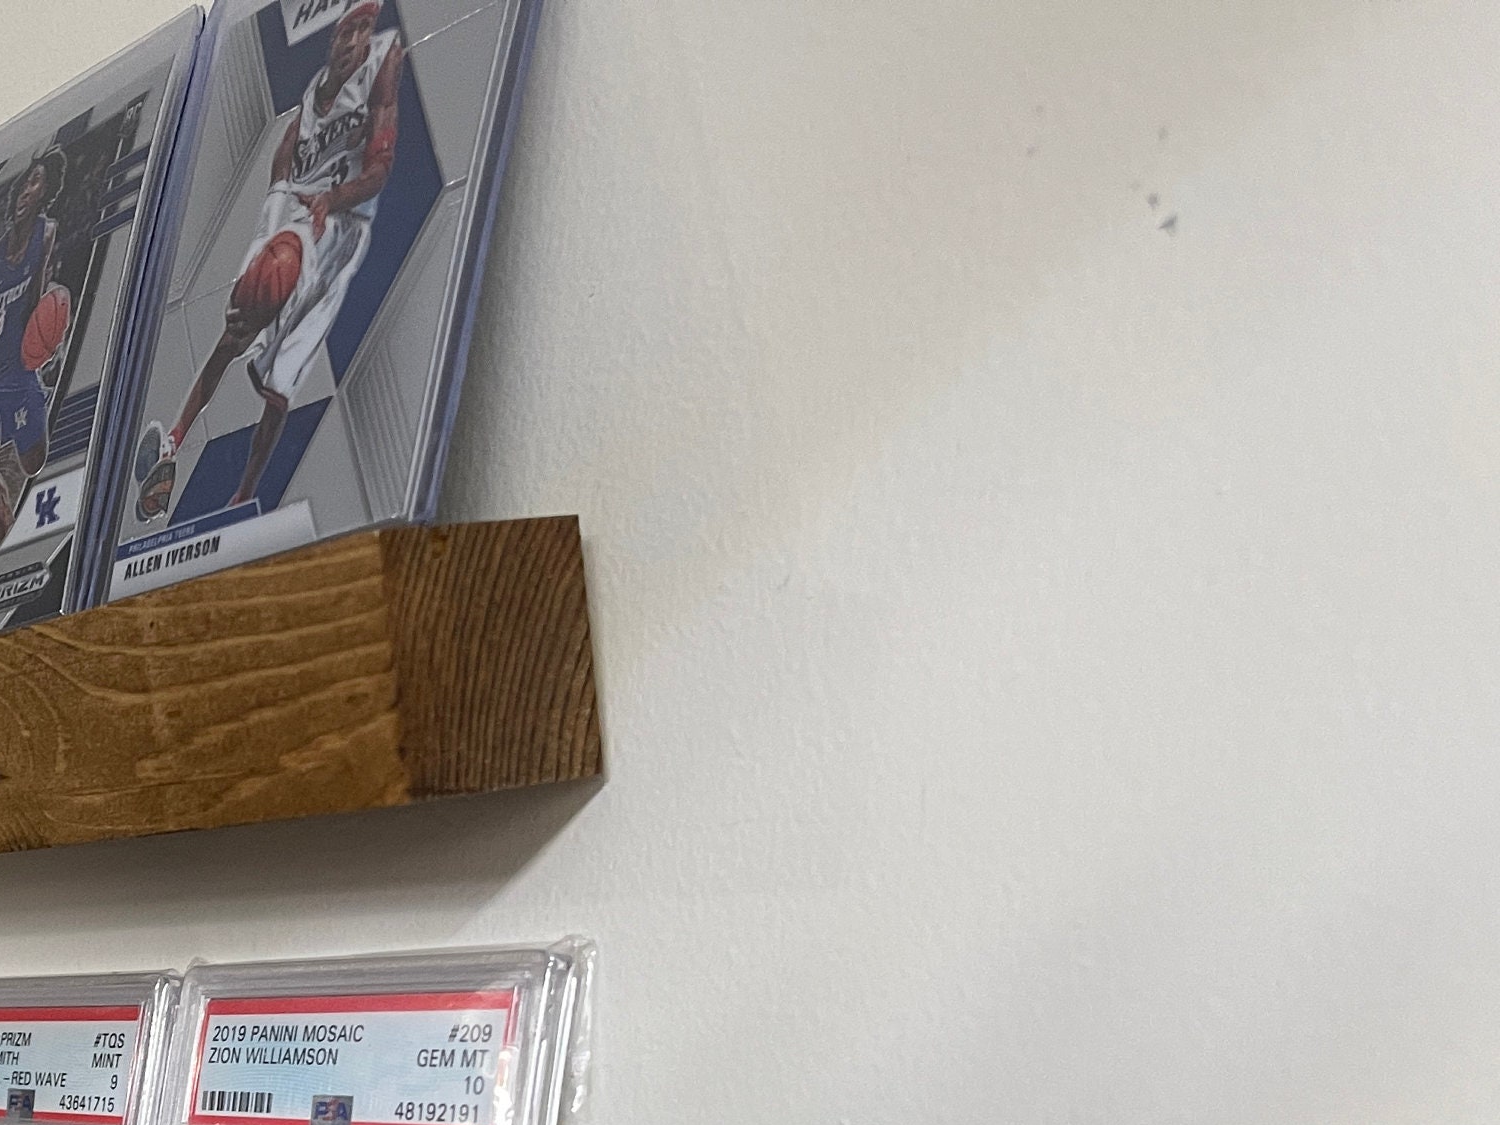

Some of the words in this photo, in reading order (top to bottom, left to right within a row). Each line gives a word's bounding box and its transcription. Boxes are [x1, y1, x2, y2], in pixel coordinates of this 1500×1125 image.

[124, 553, 162, 581] ALLEN
[165, 535, 221, 568] IVERSON
[0, 1032, 32, 1047] PRIZM
[94, 1033, 125, 1049] #TQS
[212, 1025, 246, 1042] 2019
[250, 1025, 298, 1042] PANINI
[302, 1024, 364, 1042] MOSAIC
[448, 1023, 493, 1043] #209
[92, 1053, 122, 1069] MINT
[208, 1047, 240, 1065] ZION
[245, 1047, 338, 1066] WILLIAMSON
[417, 1049, 454, 1068] GEM
[461, 1049, 490, 1069] MT
[35, 1073, 67, 1088] WAVE
[110, 1074, 118, 1090] 9
[464, 1075, 484, 1095] 10
[59, 1095, 115, 1113] 43641715
[394, 1102, 480, 1123] 48192191
